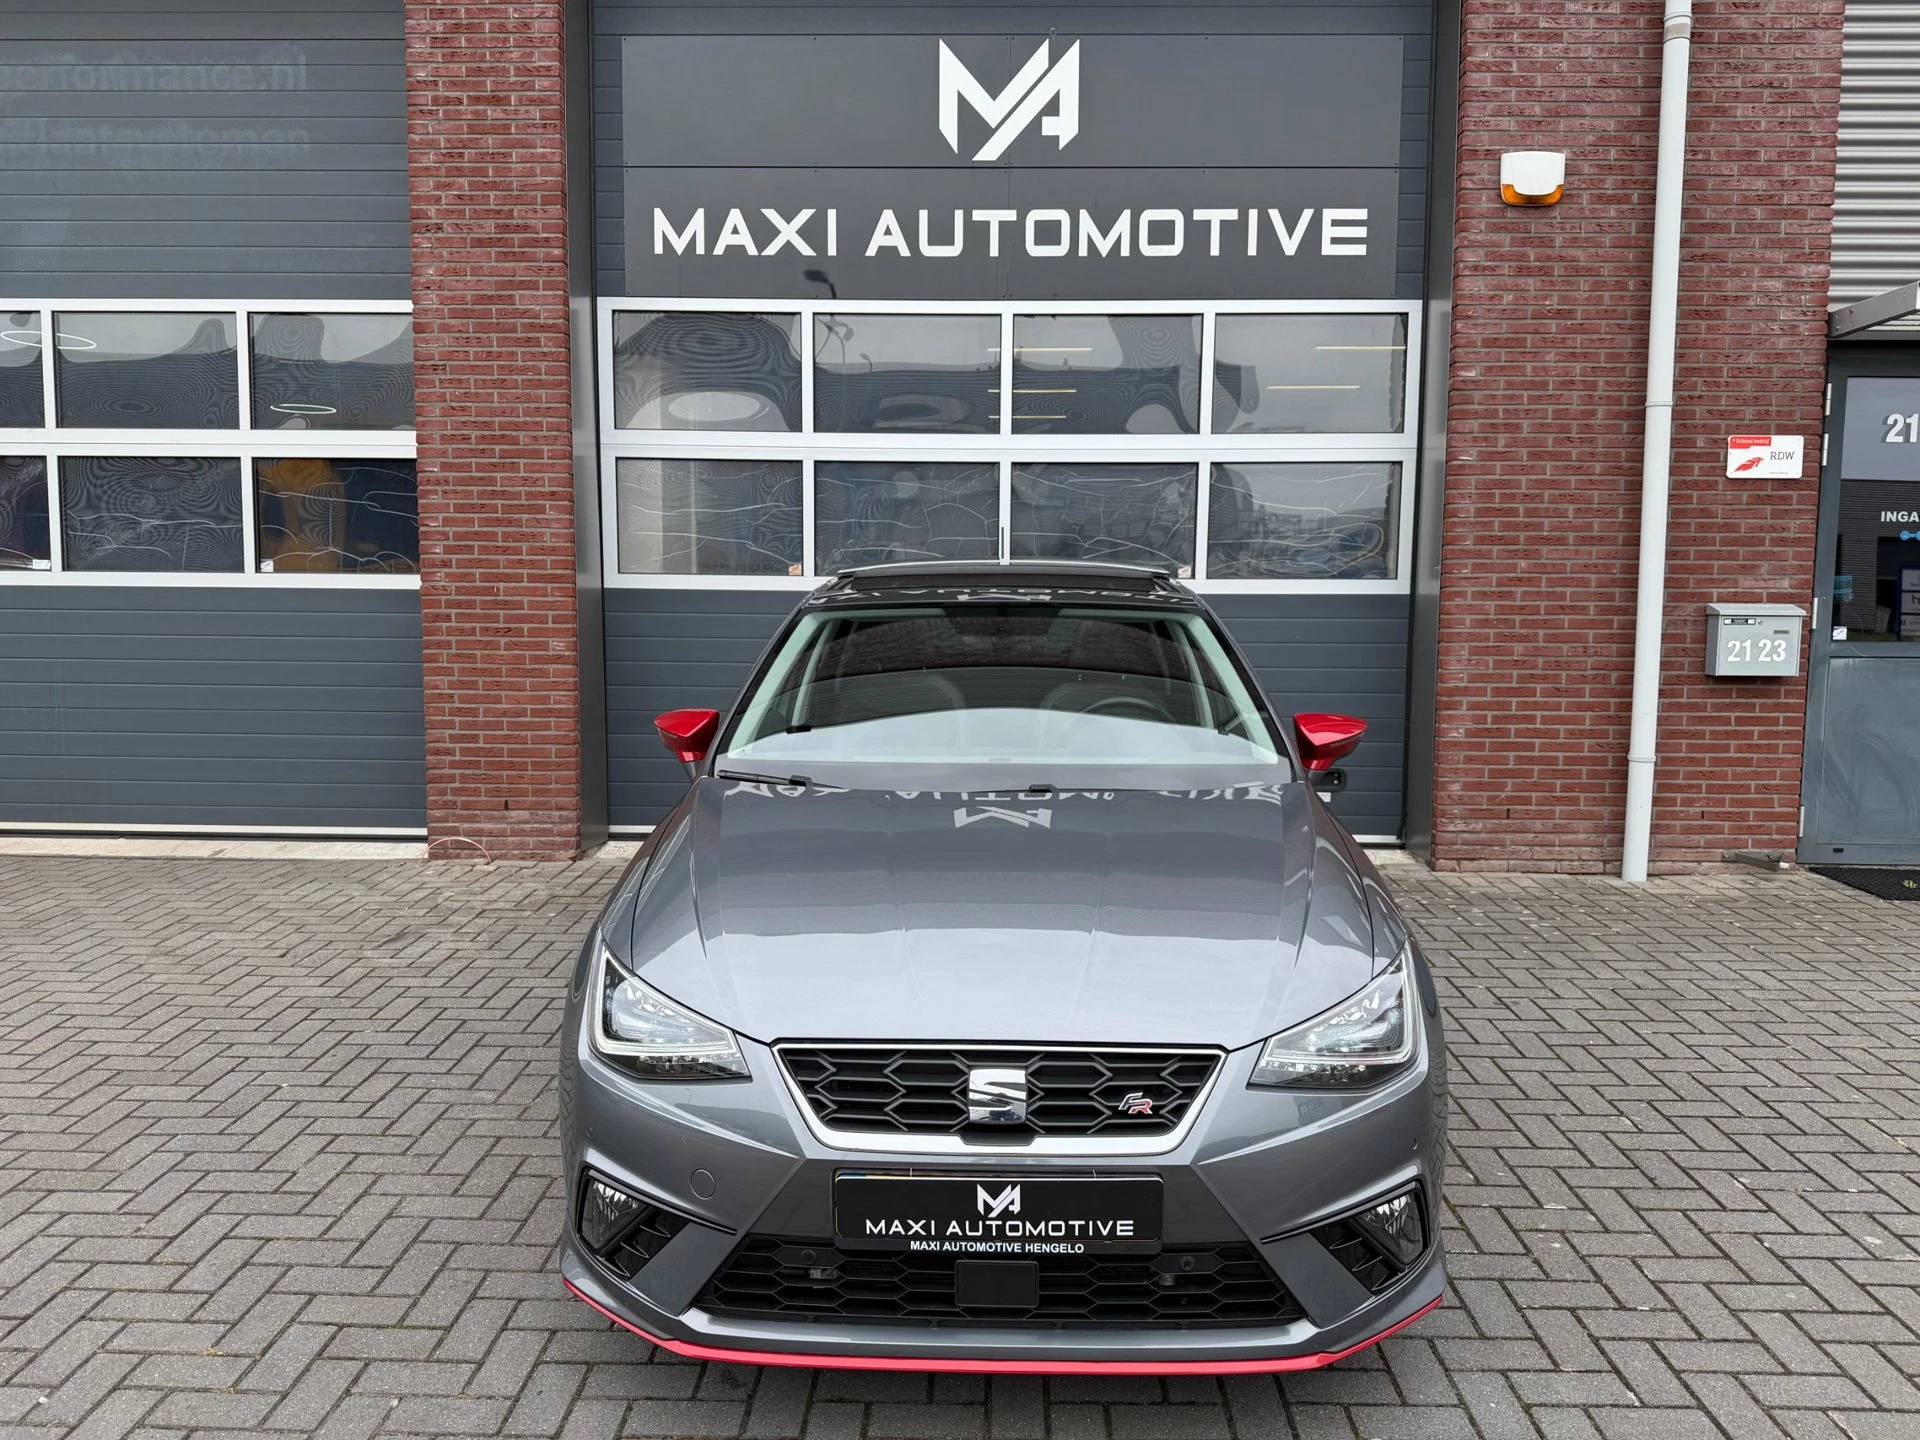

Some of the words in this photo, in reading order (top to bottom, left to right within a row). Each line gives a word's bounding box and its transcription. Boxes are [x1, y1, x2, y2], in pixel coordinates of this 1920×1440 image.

[653, 207, 837, 257] MAXI
[865, 208, 1369, 258] AUTOMOTIVE
[1770, 451, 1795, 461] RDW
[1118, 1092, 1153, 1115] FR
[865, 1218, 935, 1236] MAXI
[945, 1219, 1134, 1236] AUTOMOTIVE
[910, 1240, 939, 1251] MAXI
[943, 1241, 1022, 1253] AUTOMOTIVE
[1025, 1242, 1085, 1254] HENGELO
